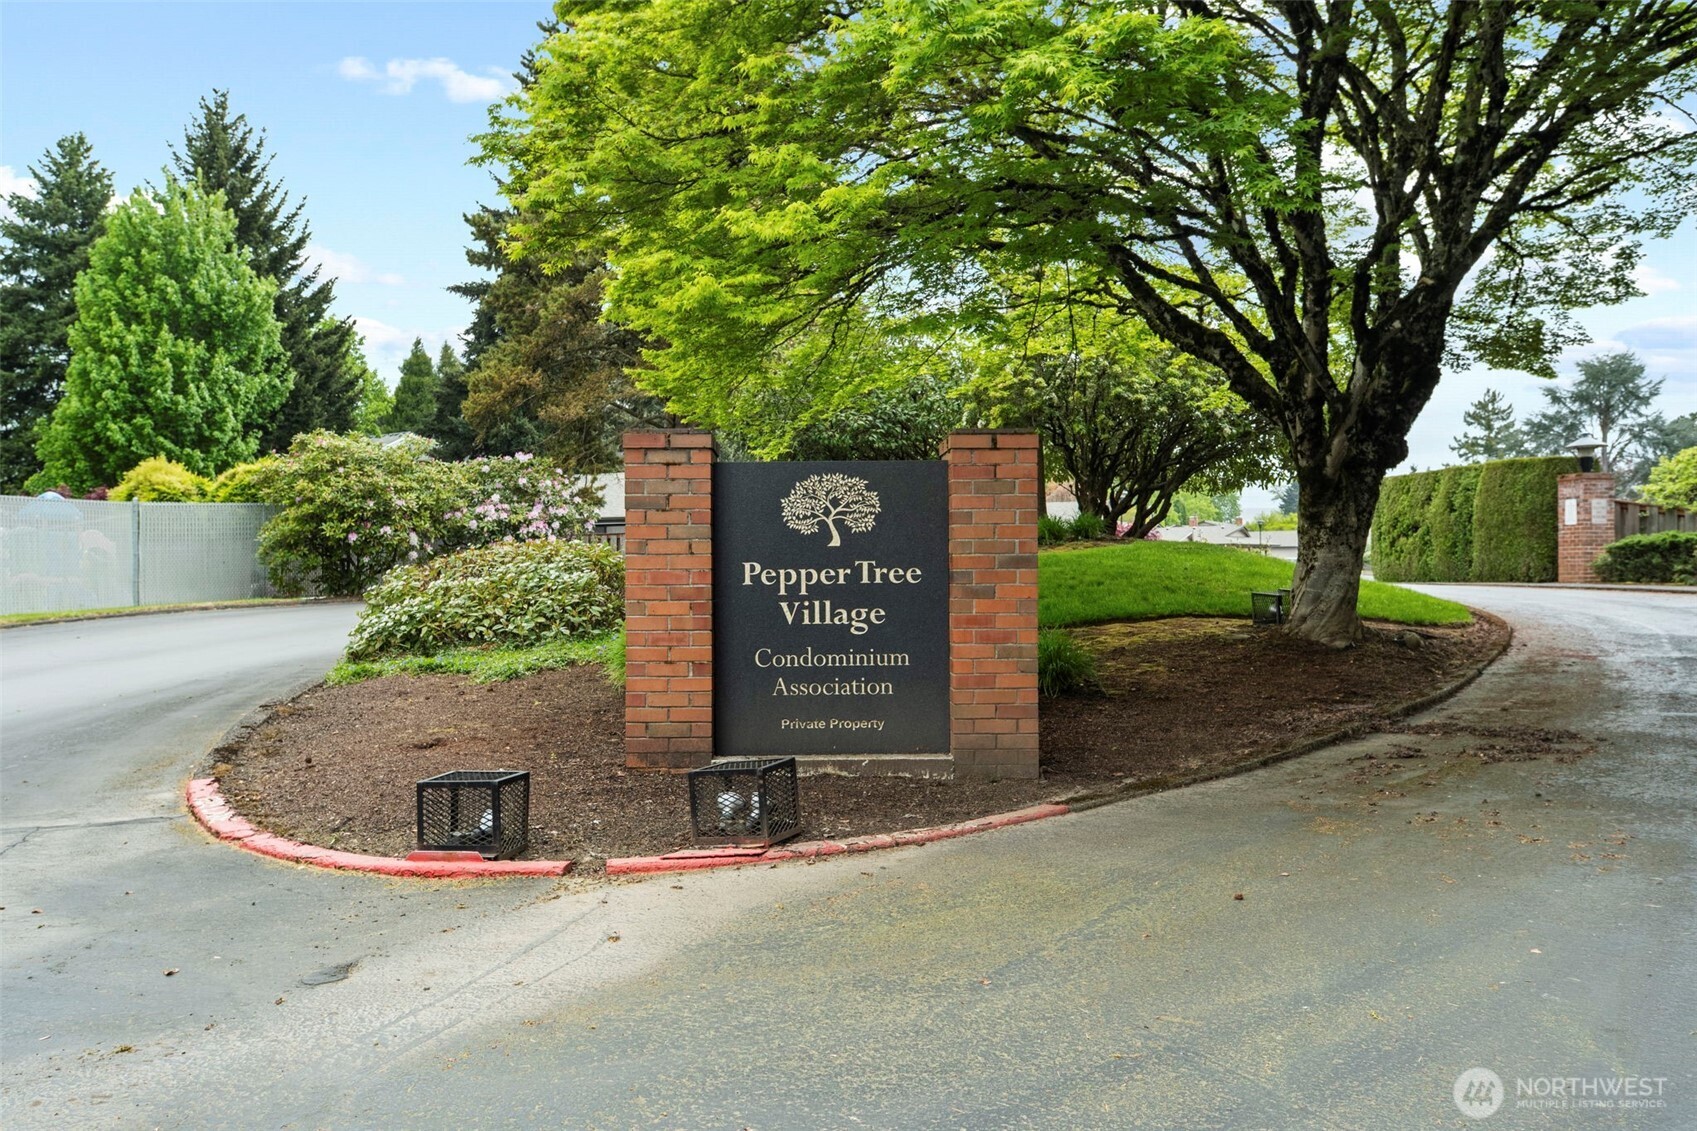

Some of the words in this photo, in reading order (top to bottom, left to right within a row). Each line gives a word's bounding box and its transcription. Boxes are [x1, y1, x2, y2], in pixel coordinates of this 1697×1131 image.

[742, 562, 850, 595] Pepper
[854, 560, 922, 585] Tree
[779, 600, 886, 635] Village
[755, 647, 910, 668] Condominium
[772, 677, 894, 696] Association
[781, 718, 826, 730] Private
[829, 718, 885, 731] Property
